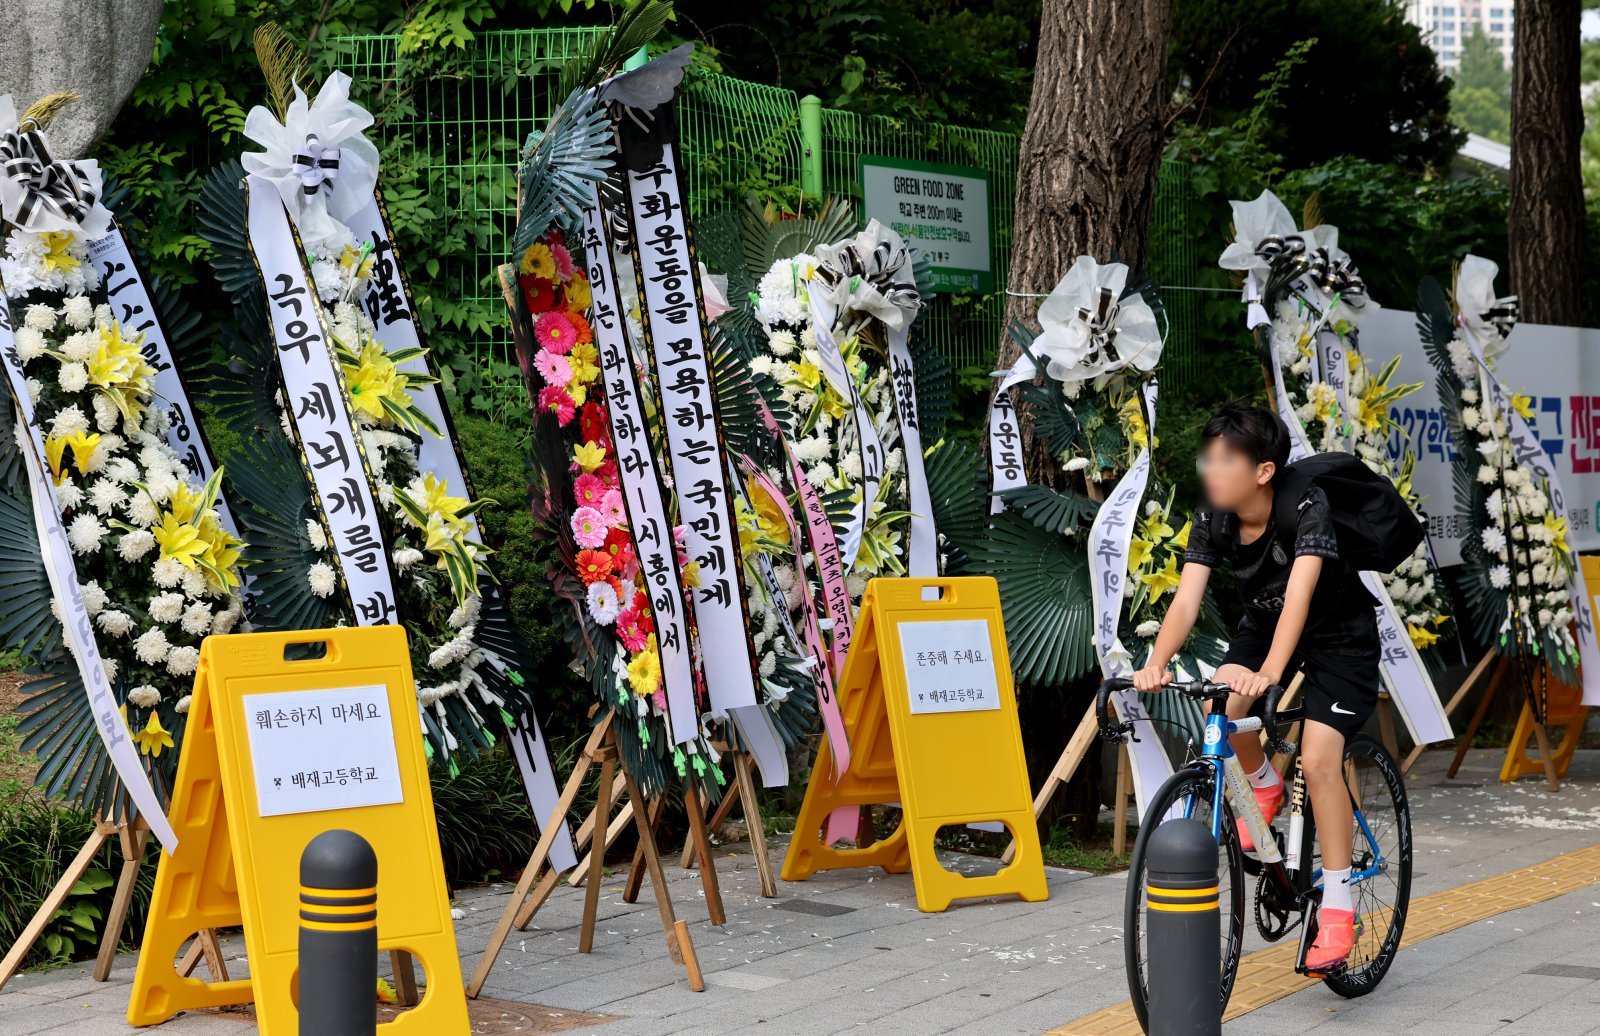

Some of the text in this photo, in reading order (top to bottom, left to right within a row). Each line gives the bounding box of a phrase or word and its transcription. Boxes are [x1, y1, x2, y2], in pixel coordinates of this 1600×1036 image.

[894, 176, 964, 201] GREEN FOOD ZONE
[927, 205, 946, 221] 200m
[603, 344, 649, 478] 과분하다
[662, 337, 716, 465] 모욕하는
[270, 274, 320, 365] 극우
[297, 382, 382, 574] 세뇌개를
[684, 479, 732, 609] 국민에게
[916, 649, 988, 667] 존중해 주세요.
[929, 688, 985, 704] 배재고등학교
[255, 702, 382, 730] 훼손하지 마세요
[291, 766, 379, 790] 배재고등학교
